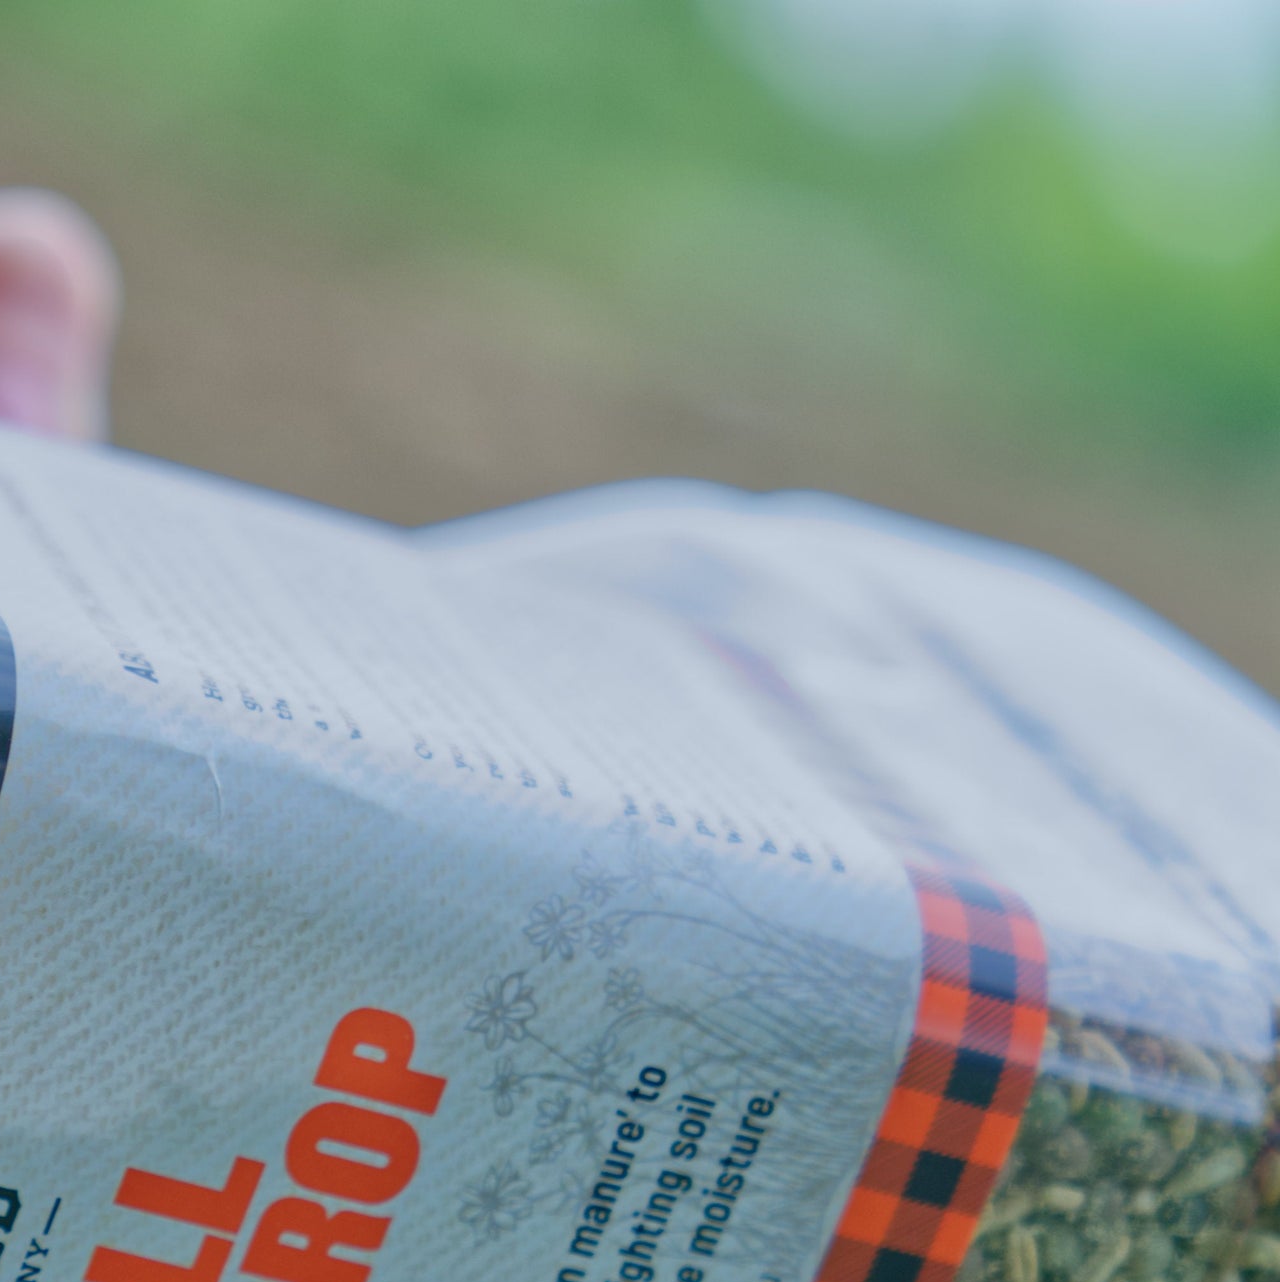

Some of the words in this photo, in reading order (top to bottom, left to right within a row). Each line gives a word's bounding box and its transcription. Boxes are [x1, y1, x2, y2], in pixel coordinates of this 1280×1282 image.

[624, 1065, 668, 1103] to
[669, 1092, 716, 1161] soil
[688, 1088, 784, 1258] moisture.
